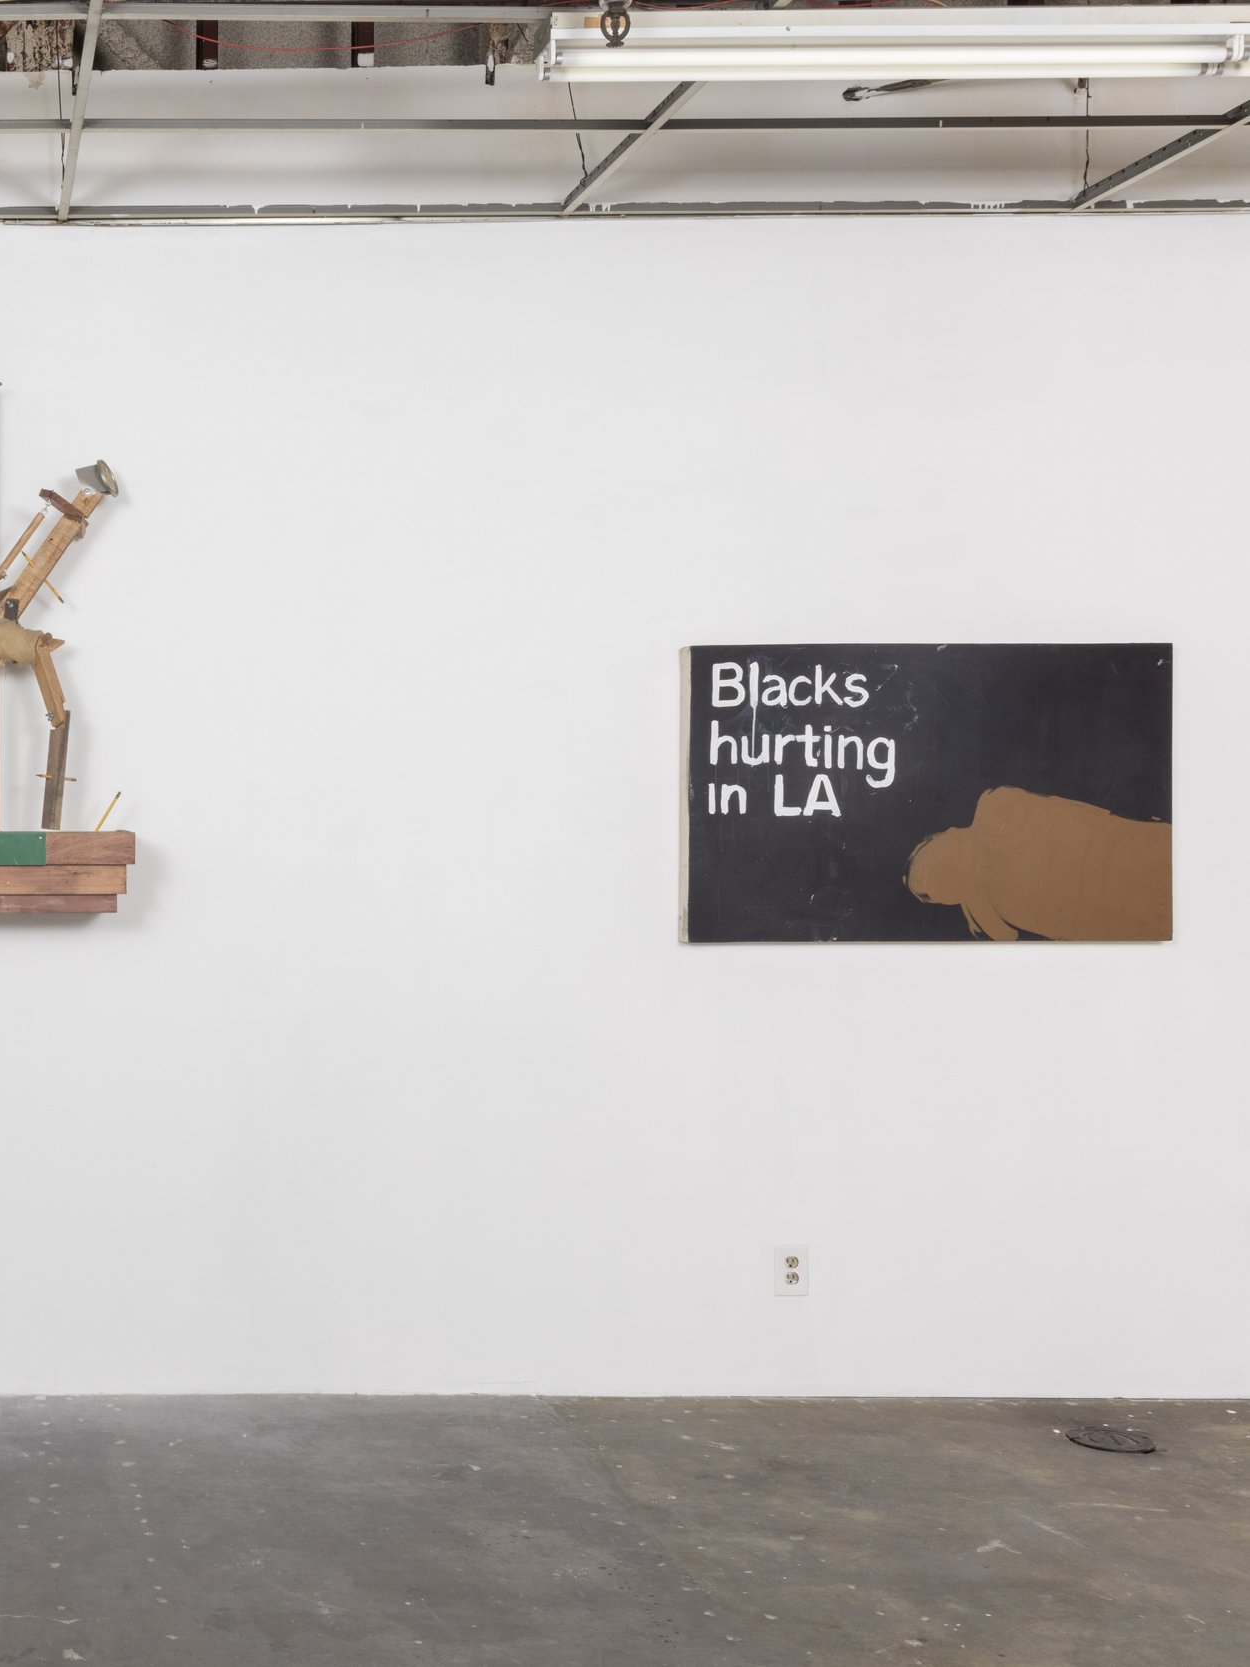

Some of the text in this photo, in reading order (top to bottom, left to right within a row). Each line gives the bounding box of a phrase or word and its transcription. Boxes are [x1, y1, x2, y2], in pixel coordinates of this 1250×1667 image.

[711, 661, 870, 709] Blacks
[709, 719, 896, 789] hurting
[707, 773, 842, 818] in LA
